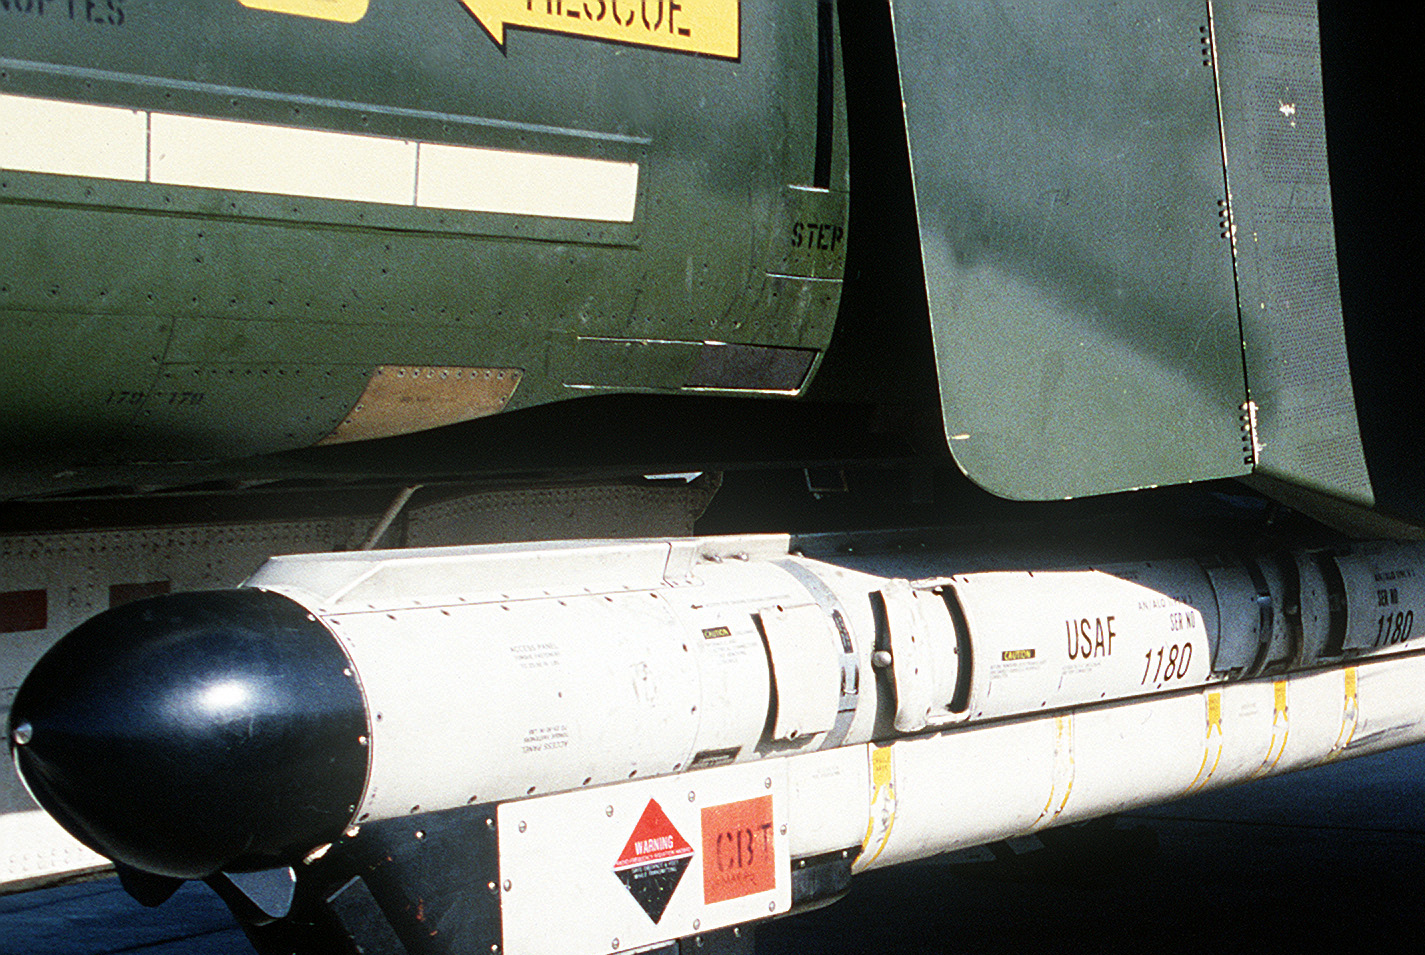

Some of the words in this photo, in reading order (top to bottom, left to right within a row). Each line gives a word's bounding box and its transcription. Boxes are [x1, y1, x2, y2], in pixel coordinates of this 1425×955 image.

[791, 222, 845, 252] STEP
[1065, 615, 1117, 660] USAF
[1170, 612, 1184, 632] SER
[1374, 610, 1414, 648] 1180
[1003, 649, 1033, 661] CAUTION
[1141, 642, 1193, 686] 1180
[634, 835, 674, 856] WARNING
[717, 822, 772, 872] CBT
